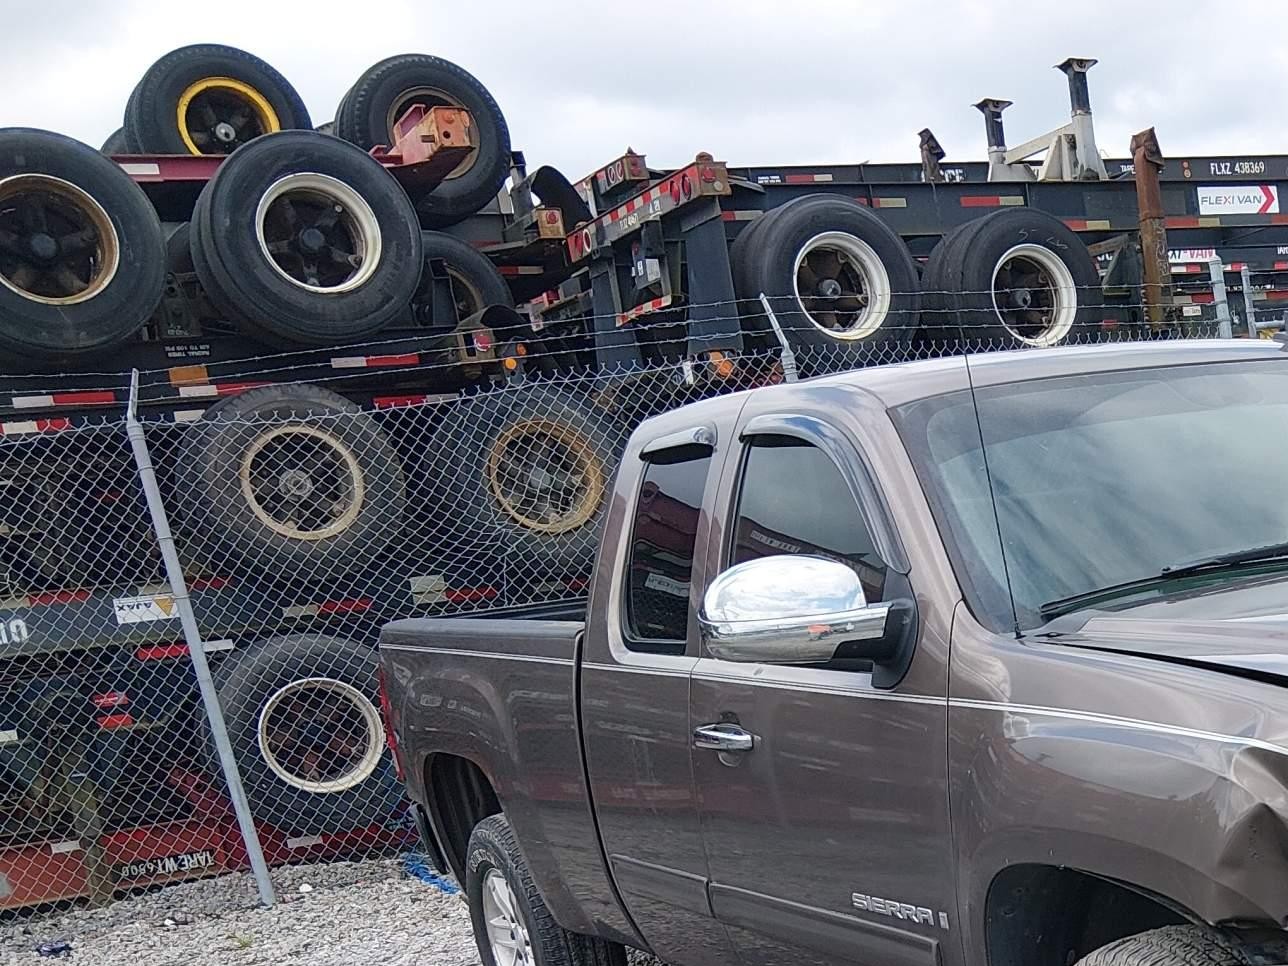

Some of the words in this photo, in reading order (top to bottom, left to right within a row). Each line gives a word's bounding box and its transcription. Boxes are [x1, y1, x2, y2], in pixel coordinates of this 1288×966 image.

[1210, 162, 1232, 175] FLXZ
[1234, 161, 1265, 174] 438369
[1201, 195, 1234, 206] FLEXI
[1237, 195, 1263, 205] VAN
[117, 602, 152, 613] AJAX
[852, 892, 934, 926] SIERRA
